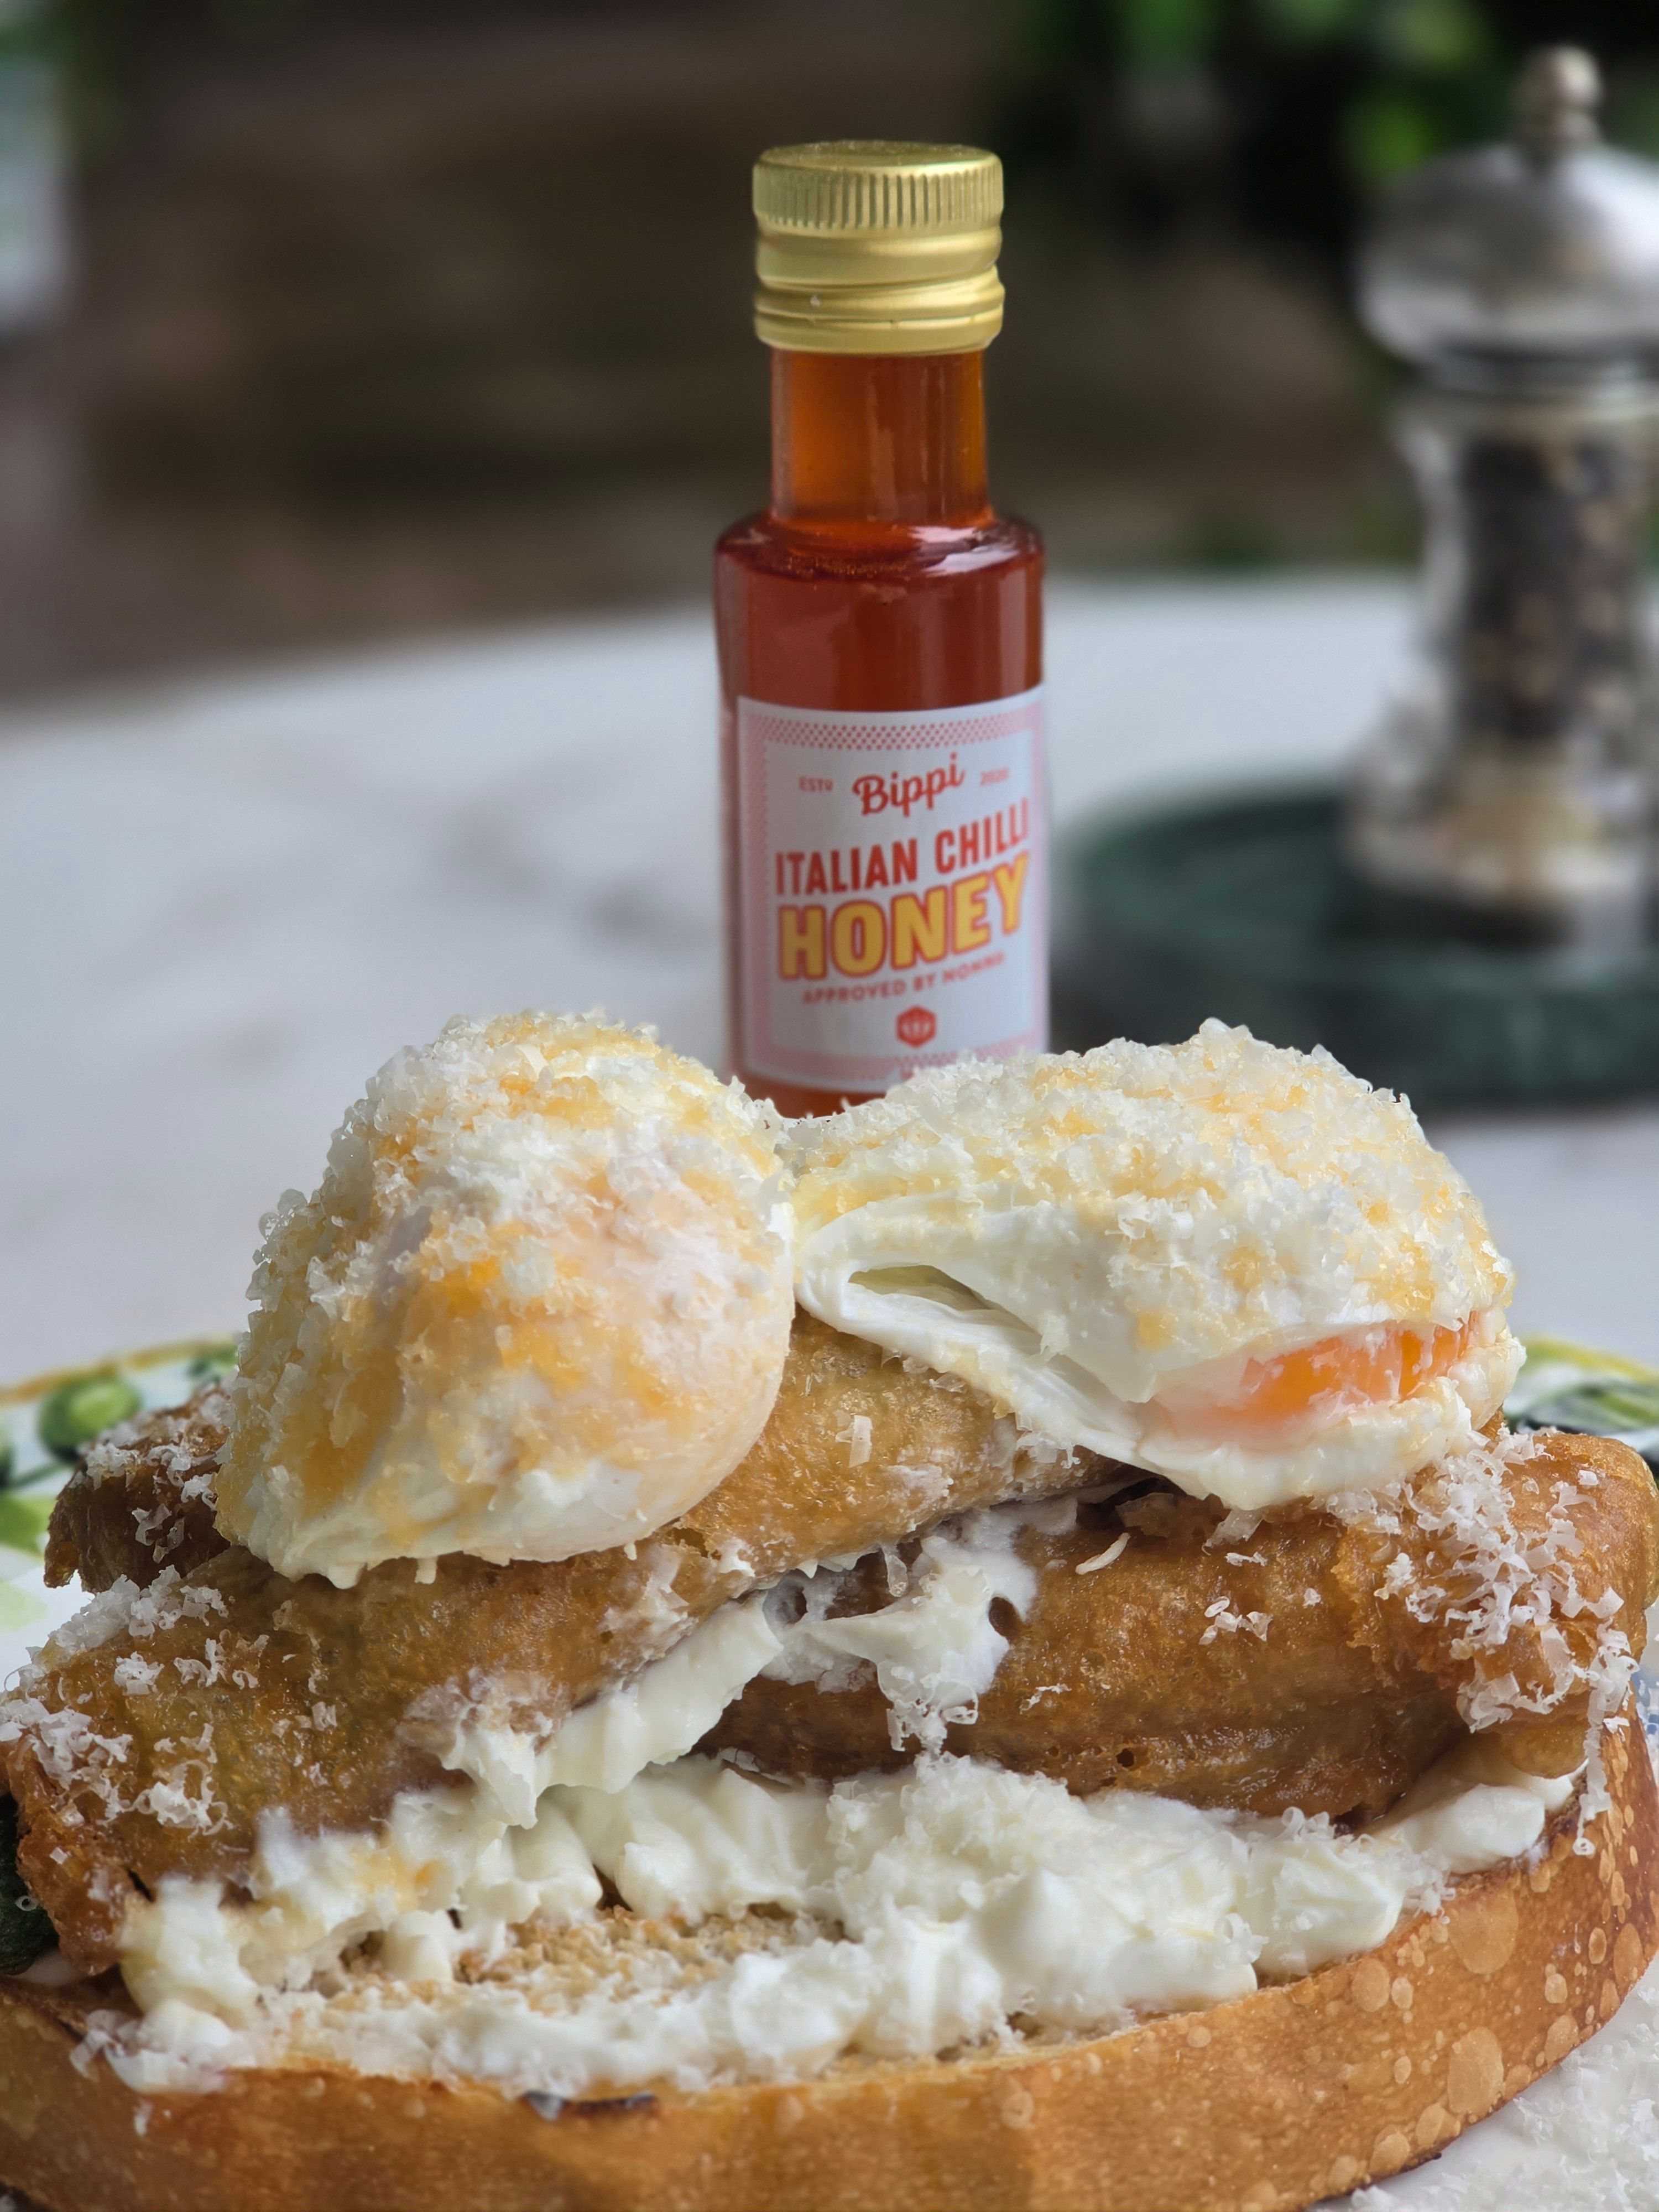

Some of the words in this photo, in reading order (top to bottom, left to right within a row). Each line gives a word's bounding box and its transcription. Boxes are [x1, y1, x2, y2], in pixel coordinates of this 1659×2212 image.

[852, 752, 964, 817] Bippi
[776, 838, 918, 895] ITALIAN
[935, 796, 1029, 874] CHILLI
[779, 850, 1029, 980] HONEY
[802, 980, 906, 1004] APPROVED
[914, 973, 936, 991] BY
